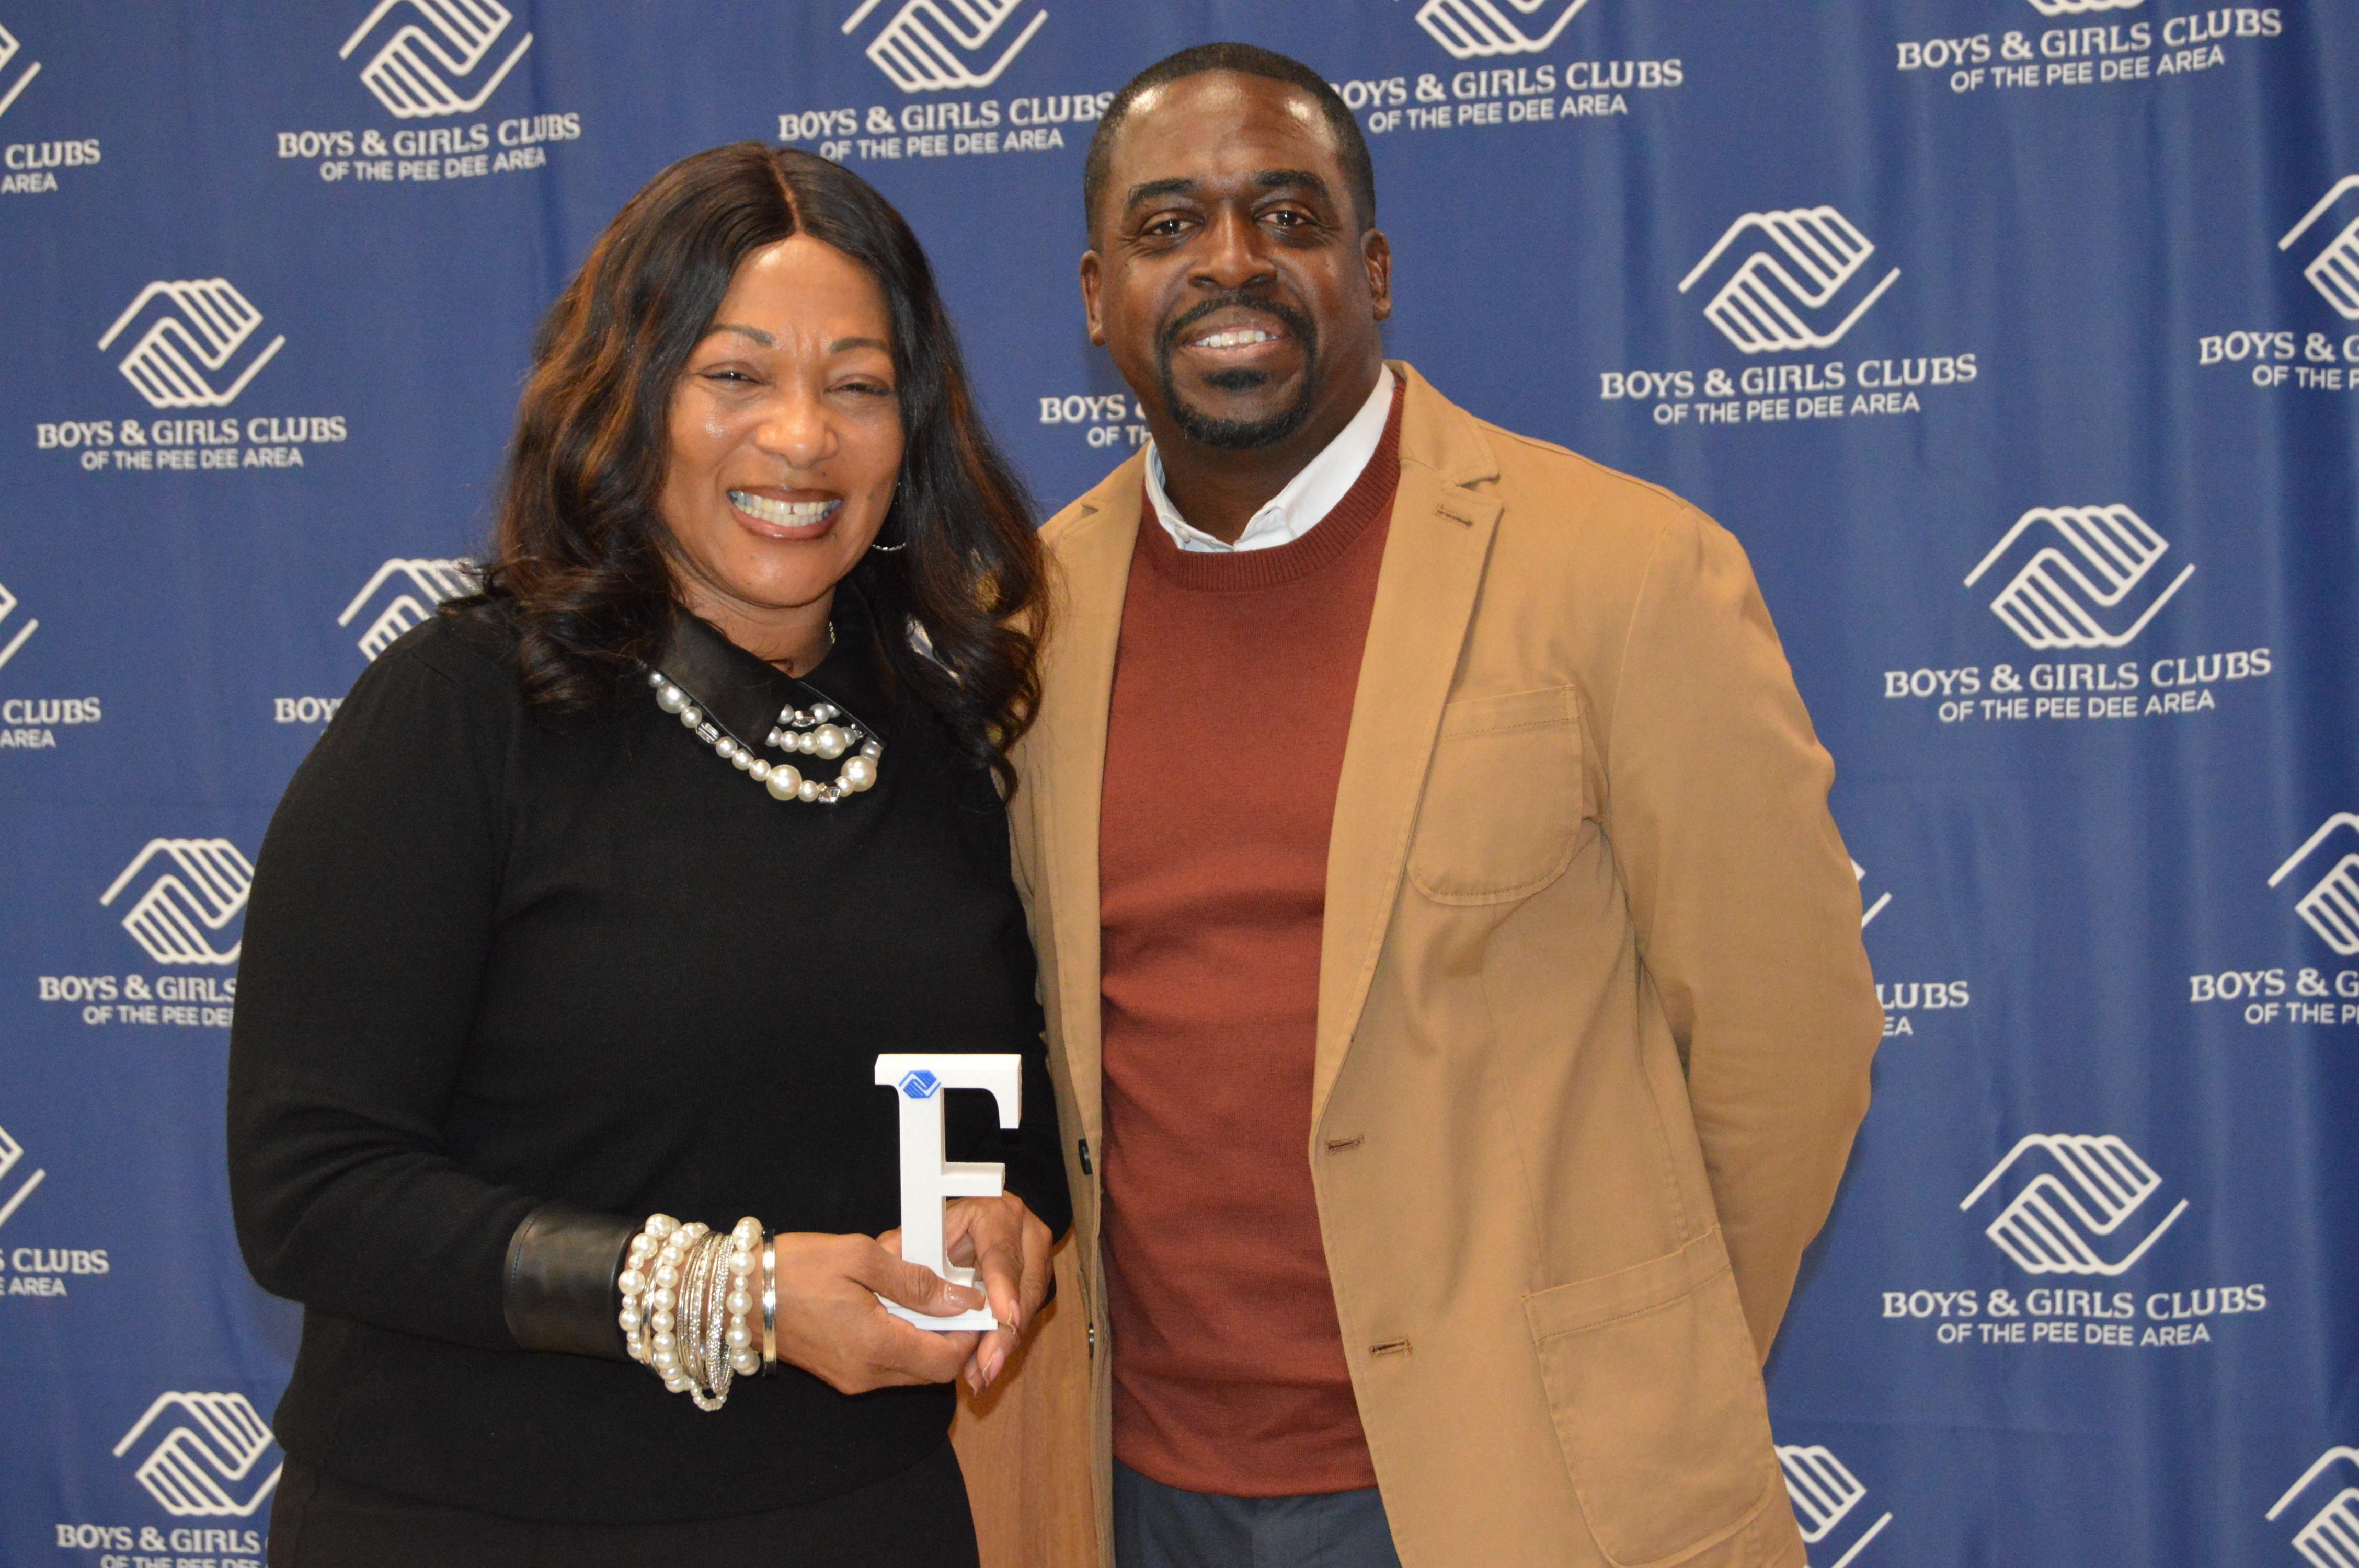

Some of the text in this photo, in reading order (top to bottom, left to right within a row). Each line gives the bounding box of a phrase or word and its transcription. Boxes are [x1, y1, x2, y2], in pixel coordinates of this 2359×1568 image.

[1897, 8, 2282, 70] BOYS & GIRLS CLUBS
[1950, 44, 2225, 93] OF THE PEE DEE AREA
[1329, 58, 1684, 110] OYS & GIRLS CLUBS
[778, 108, 858, 141] BOYS
[865, 106, 897, 134] &
[900, 100, 1001, 132] GIRLS
[1368, 94, 1628, 134] OF THE PEE DEE AREA
[277, 112, 581, 158] BOYS & GIRLS CLUBS
[820, 128, 1064, 161] OF THE PEE DEE AREA
[5, 139, 101, 169] CLUBS
[319, 147, 546, 182] OF THE PEE DEE AREA
[1, 172, 58, 193] AREA
[2199, 330, 2295, 365] BOYS
[2305, 332, 2336, 362] &
[1600, 353, 1978, 400] BOYS & GIRLS CLUBS
[2252, 364, 2289, 387] OF
[2295, 366, 2341, 389] THE
[1039, 394, 1126, 424] BOYS
[1653, 391, 1920, 425] OF THE PEE DEE AREA
[36, 416, 347, 449] BOYS & GIRLS CLUBS
[1086, 425, 1120, 448] OF
[81, 447, 304, 470] OF THE PEE DEE AREA
[1884, 648, 2272, 698] BOYS & GIRLS CLUBS
[2, 697, 101, 725] CLUBS
[274, 696, 344, 724] BOY
[1938, 688, 2215, 723] OF THE PEE DEE AREA
[0, 729, 56, 748] AREA
[38, 975, 119, 1002] BOYS
[123, 974, 153, 1001] &
[1875, 980, 1970, 1010] LUBS
[2190, 968, 2287, 1002] BOYS
[2296, 967, 2329, 996] &
[82, 1005, 113, 1025] OF
[117, 1005, 158, 1024] THE
[162, 1005, 199, 1026] PEE
[2245, 1002, 2280, 1025] OF
[2285, 1001, 2334, 1024] THE
[12, 1248, 110, 1274] CLUBS
[8, 1277, 67, 1297] AREA
[1882, 1284, 2267, 1320] BOYS & GIRLS CLUBS
[1936, 1322, 2211, 1346] OF THE PEE DEE AREA
[56, 1524, 134, 1551] BOYS
[139, 1526, 167, 1552] &
[169, 1528, 261, 1554] GIRLS
